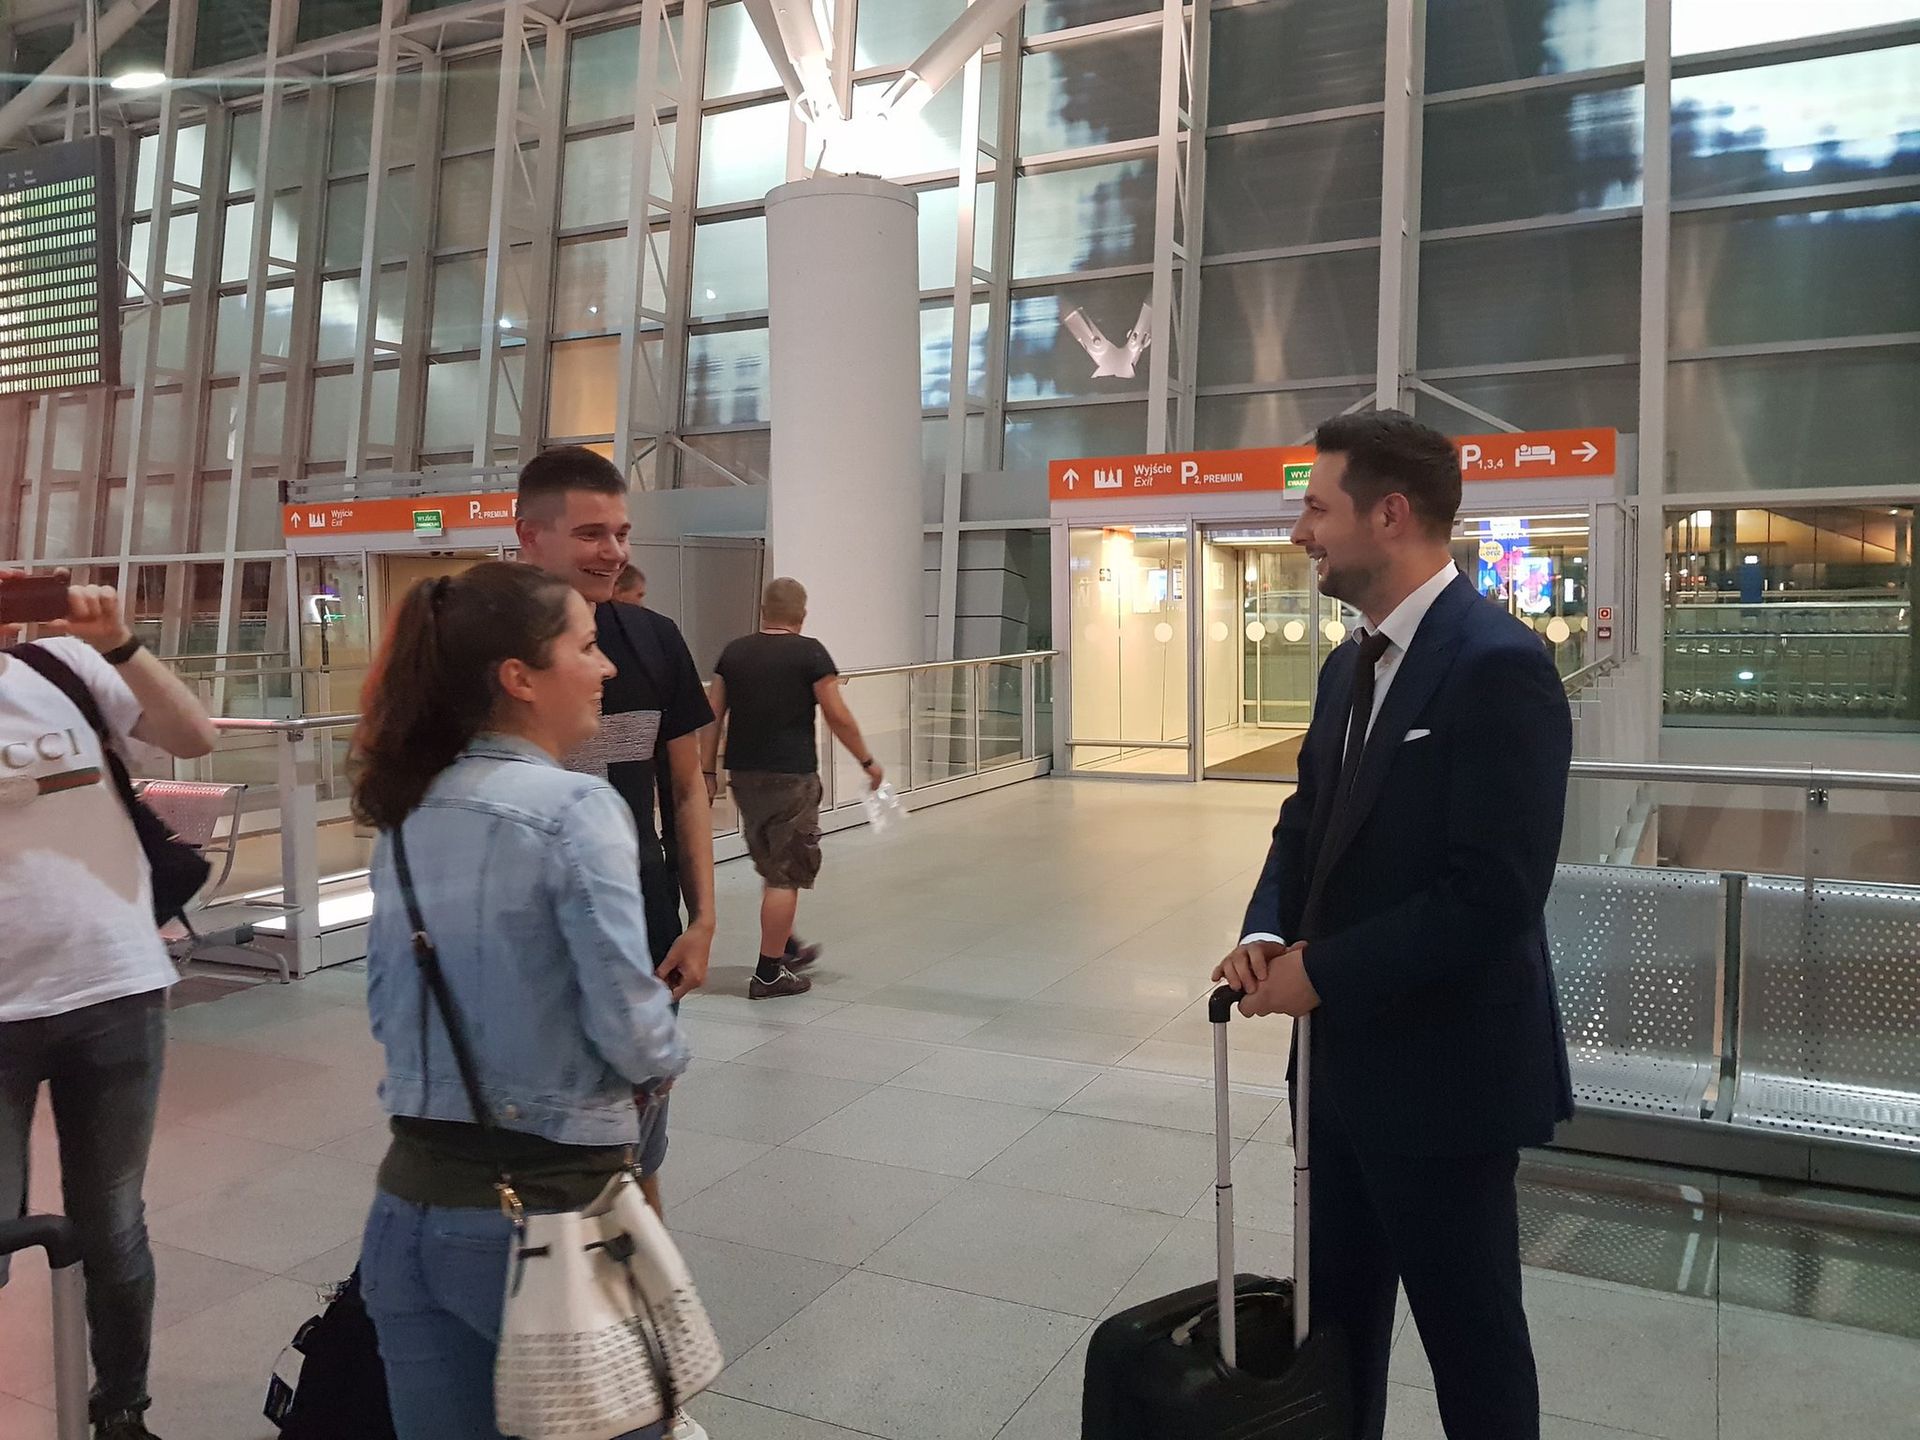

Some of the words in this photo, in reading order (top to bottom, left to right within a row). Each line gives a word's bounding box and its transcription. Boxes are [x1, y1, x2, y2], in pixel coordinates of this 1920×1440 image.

[1133, 463, 1172, 476] Wyjście
[1133, 477, 1153, 487] Exit
[1203, 472, 1243, 484] PREMIUM
[484, 509, 508, 519] PREMIUM
[330, 518, 343, 527] Exit
